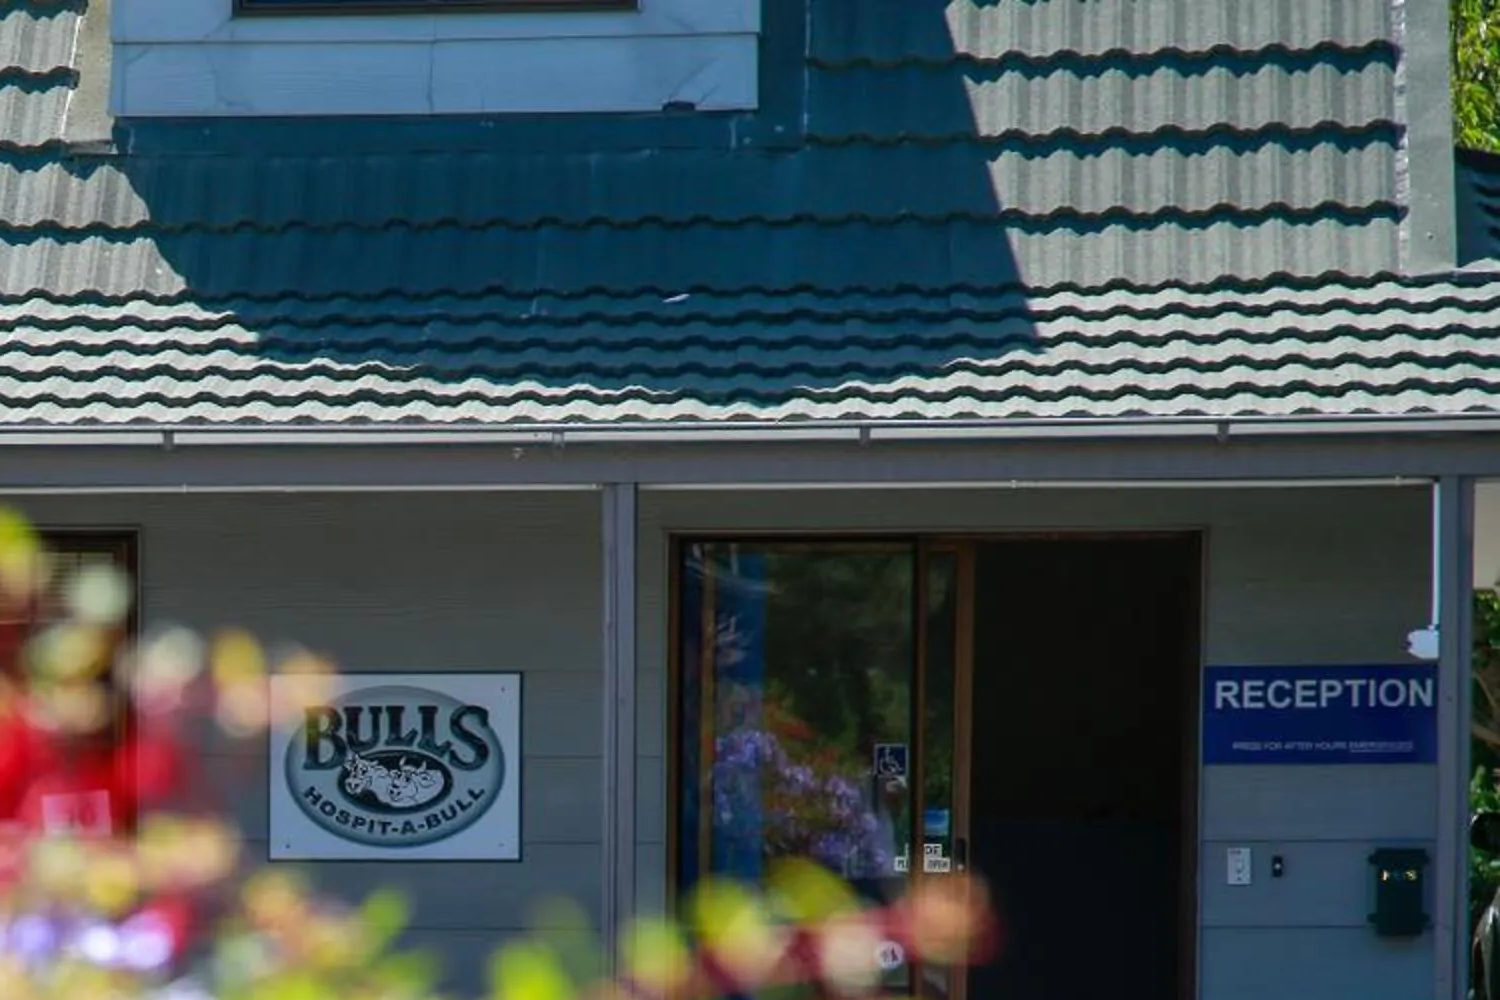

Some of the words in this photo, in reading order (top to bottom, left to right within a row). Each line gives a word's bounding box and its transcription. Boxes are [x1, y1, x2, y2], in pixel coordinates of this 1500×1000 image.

[1214, 678, 1434, 709] RECEPTION
[302, 704, 491, 771] BULLS
[303, 785, 486, 836] HOSPIT-A-BULL
